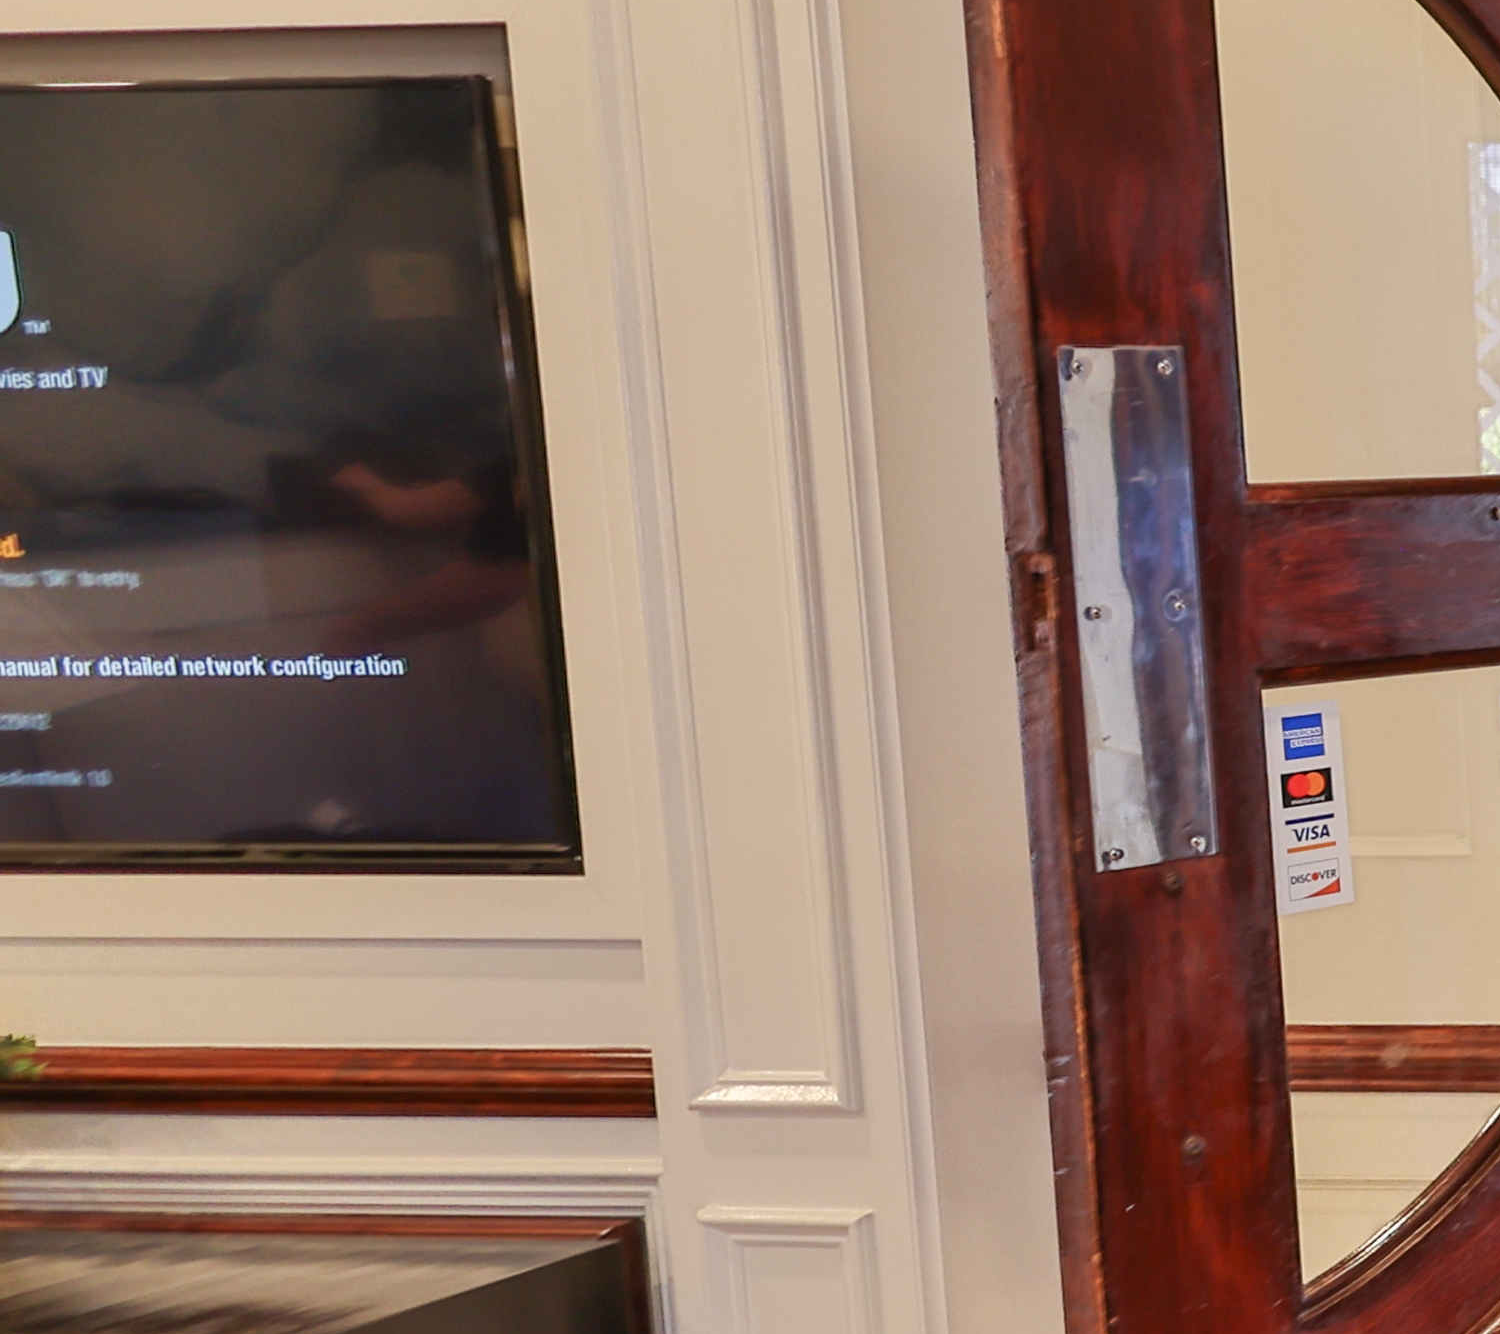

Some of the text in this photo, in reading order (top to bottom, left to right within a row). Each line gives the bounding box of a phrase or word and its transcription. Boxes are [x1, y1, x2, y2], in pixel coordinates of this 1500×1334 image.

[37, 366, 76, 388] and
[77, 365, 108, 389] TV
[63, 656, 92, 677] for
[98, 655, 177, 677] detailed
[182, 656, 267, 678] network
[271, 655, 406, 680] configuration
[1283, 727, 1320, 738] AMERICAN
[1291, 737, 1325, 747] EXPRESS
[1291, 824, 1331, 842] VISA
[1290, 869, 1337, 885] DISCOVER
